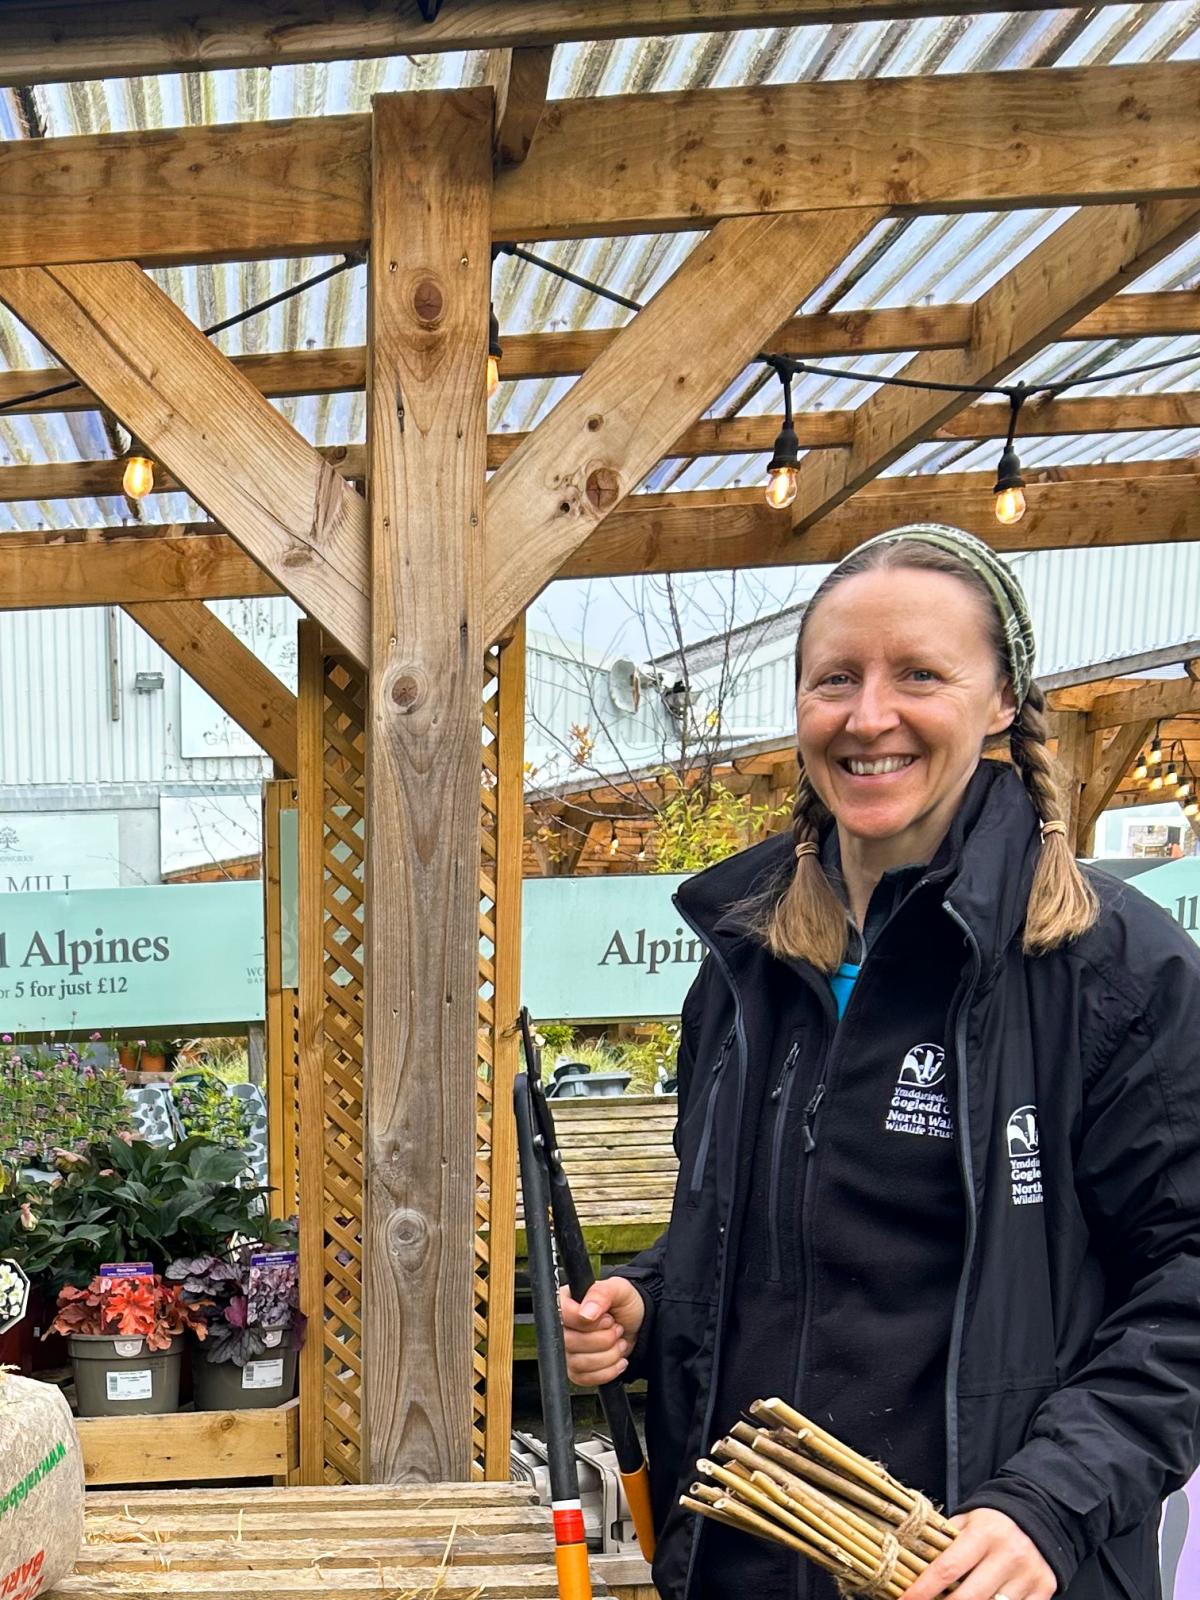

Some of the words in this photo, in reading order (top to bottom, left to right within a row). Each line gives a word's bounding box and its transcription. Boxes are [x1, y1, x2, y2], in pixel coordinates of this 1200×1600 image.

[20, 927, 170, 976] Alpines
[15, 981, 25, 998] 5
[30, 980, 56, 997] for
[58, 978, 93, 1001] just
[97, 976, 128, 994] £12
[891, 1096, 941, 1113] Gogledd
[887, 1109, 926, 1125] North
[885, 1120, 926, 1135] Wildlife
[1012, 1181, 1043, 1195] North
